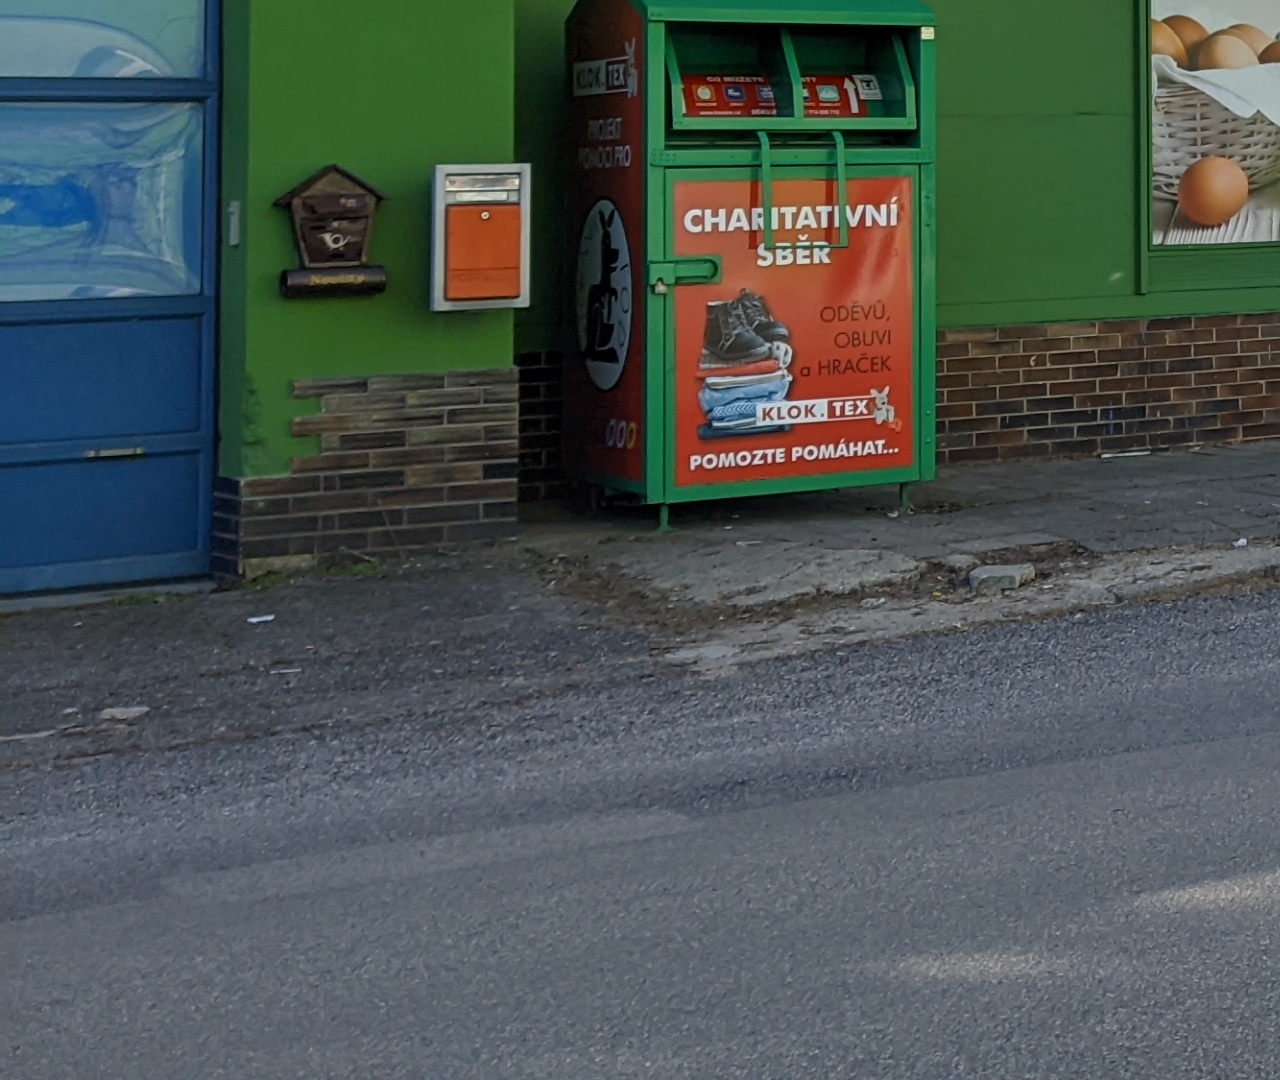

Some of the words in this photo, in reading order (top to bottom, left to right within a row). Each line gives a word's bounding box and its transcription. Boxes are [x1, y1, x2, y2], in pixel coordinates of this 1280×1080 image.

[614, 144, 632, 168] PRO
[683, 196, 899, 234] CHARITATIVNÍ
[756, 233, 832, 267] SBĚR
[820, 299, 890, 323] ODĚVŮ,
[834, 330, 891, 349] OBUVI
[800, 366, 811, 377] a
[818, 353, 892, 376] HRAČEK
[689, 445, 785, 471] POMOZTE
[791, 438, 899, 462] POMÁHAT...
